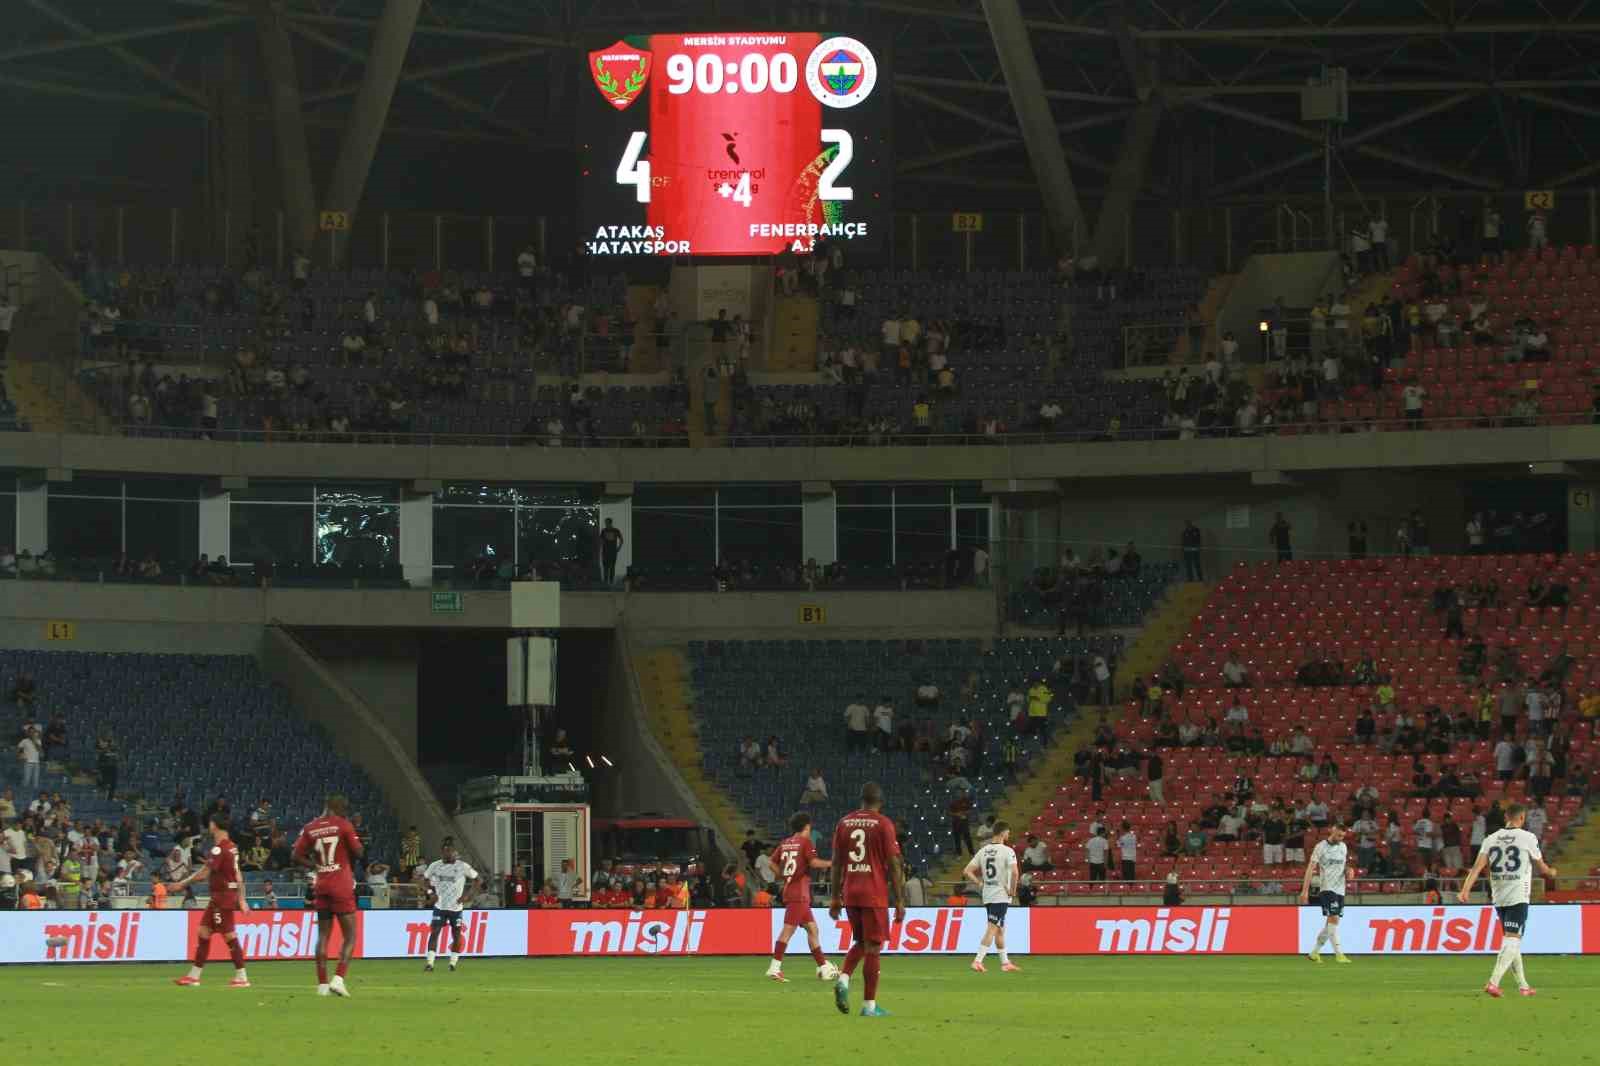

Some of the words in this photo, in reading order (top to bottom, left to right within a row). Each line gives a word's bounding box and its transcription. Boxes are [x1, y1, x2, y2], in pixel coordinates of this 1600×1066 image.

[683, 35, 726, 46] MERSİN
[728, 35, 787, 46] STADYUMU
[666, 52, 798, 94] 90:00
[616, 131, 651, 203] 4
[818, 128, 854, 201] 2
[596, 225, 664, 241] ATAKAŞ
[749, 222, 867, 239] FENERBAHÇE
[803, 607, 821, 622] B1
[52, 622, 68, 639] L1
[315, 836, 340, 865] 17
[848, 828, 866, 863] 3
[1489, 845, 1521, 873] 23
[985, 857, 997, 879] 5
[44, 911, 140, 960] misli
[570, 910, 706, 954] misli
[1096, 907, 1232, 952] misli
